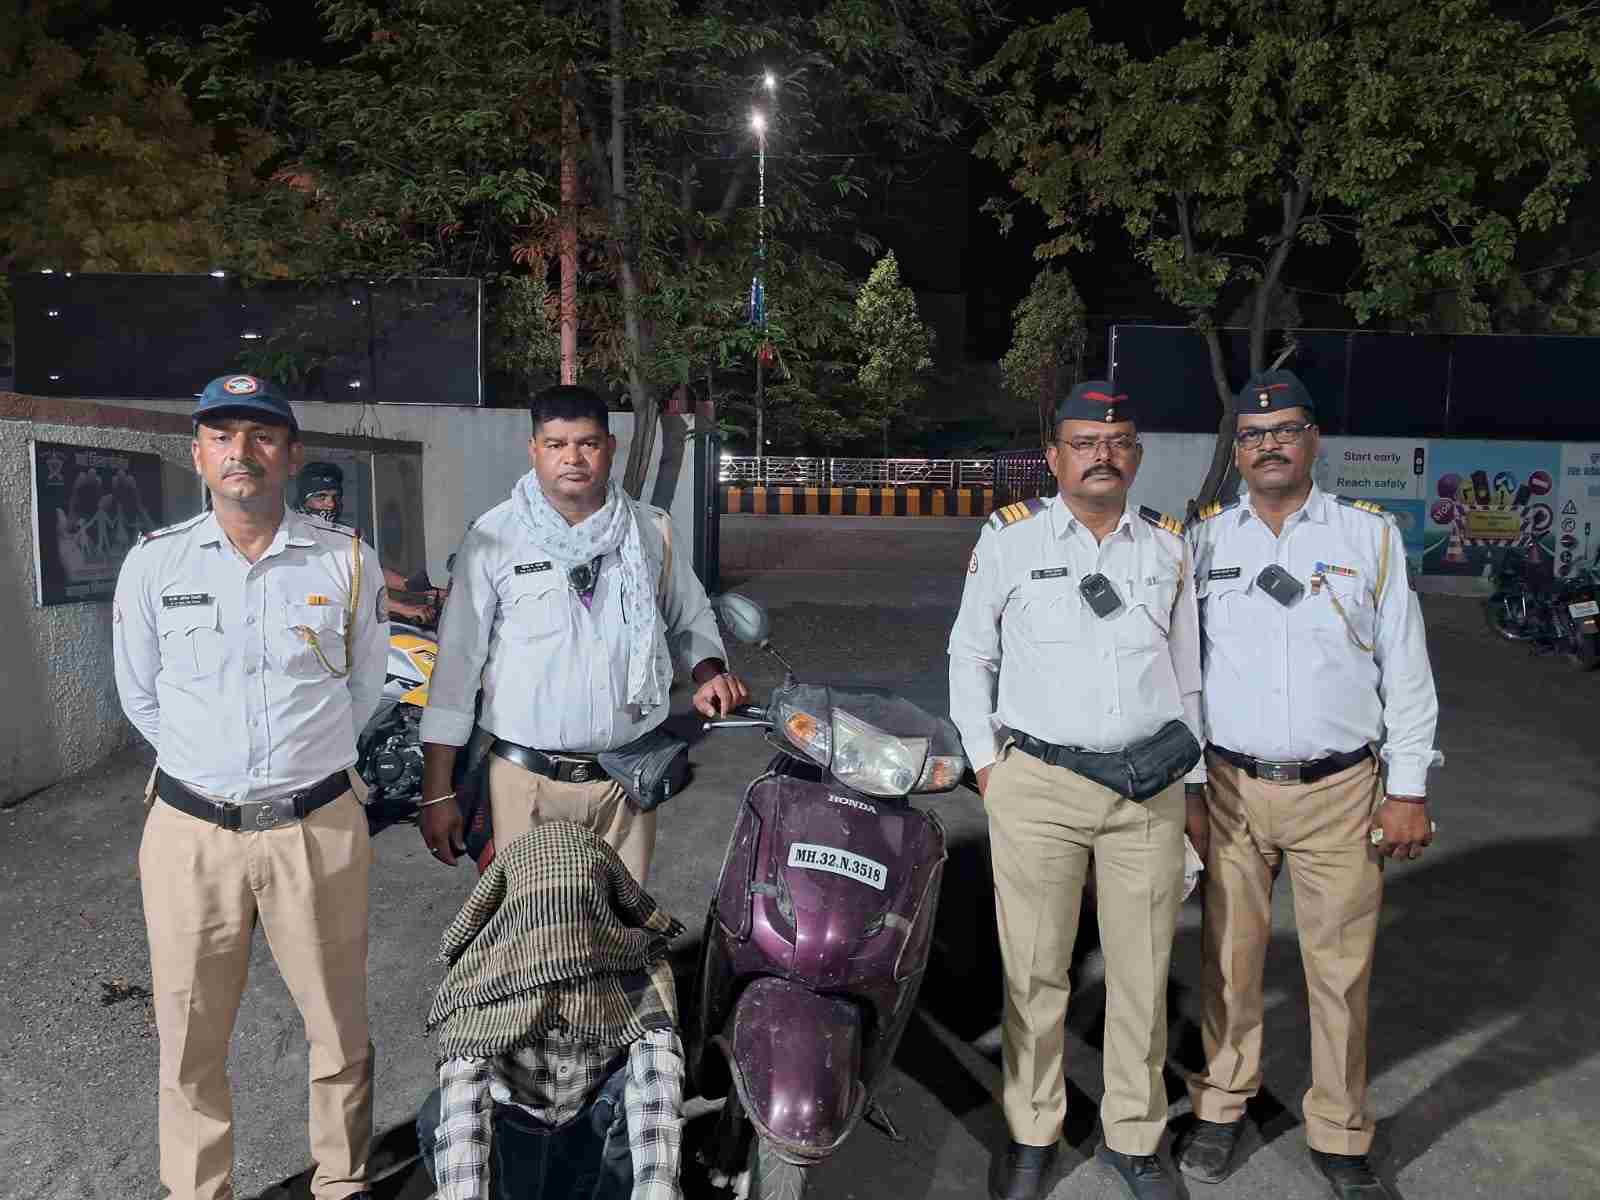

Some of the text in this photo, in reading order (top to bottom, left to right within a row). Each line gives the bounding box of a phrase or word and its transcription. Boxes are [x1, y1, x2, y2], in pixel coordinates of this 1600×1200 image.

[1344, 451, 1401, 464] Start early
[1337, 478, 1407, 490] Reach safely
[827, 795, 877, 814] HONDA
[795, 849, 881, 882] MH.32.N.3518
